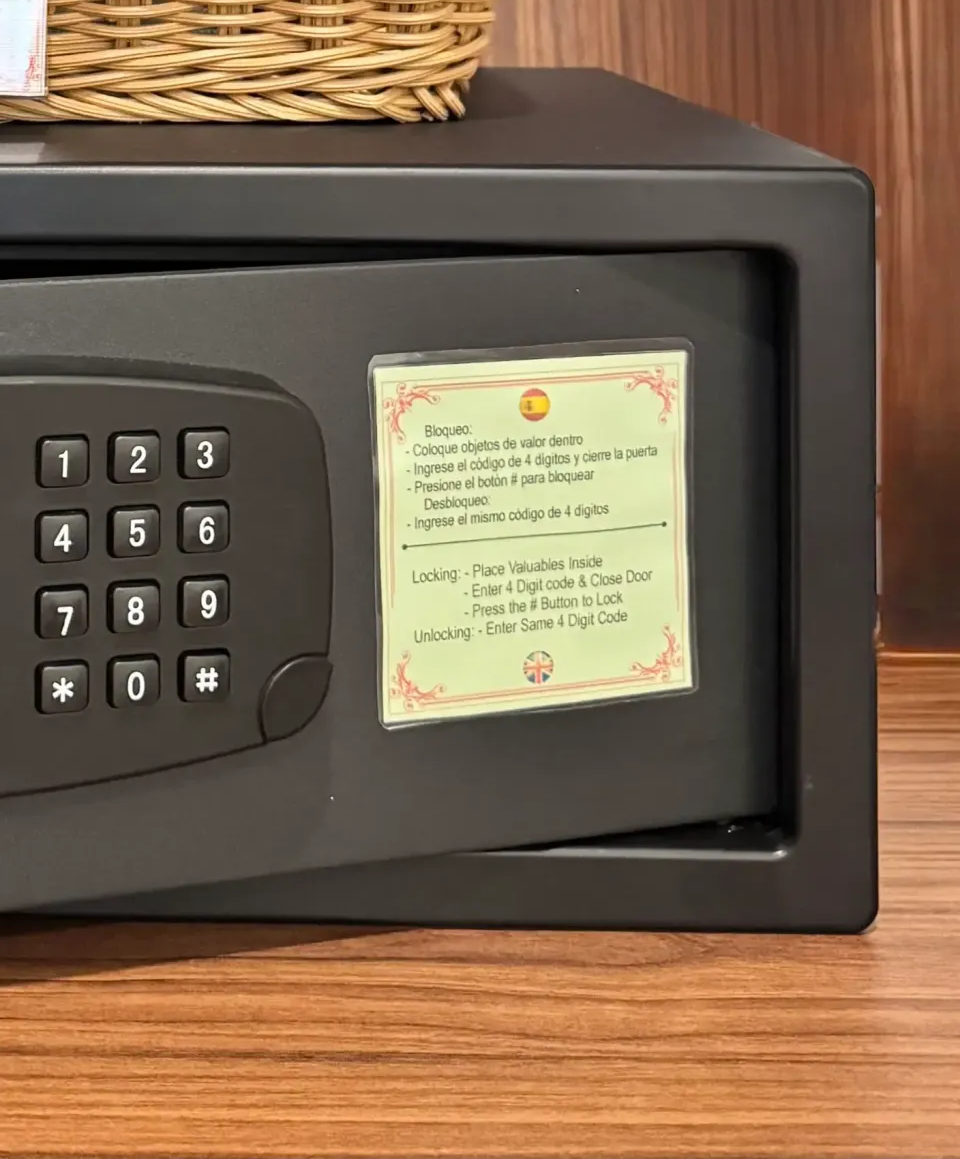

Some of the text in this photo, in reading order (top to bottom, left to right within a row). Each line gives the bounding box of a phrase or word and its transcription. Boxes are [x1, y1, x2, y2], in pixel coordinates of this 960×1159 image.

[413, 442, 458, 458] Coloque
[461, 439, 500, 456] objetos
[503, 437, 517, 450] de
[520, 436, 546, 449] valor
[549, 434, 584, 448] dentro
[424, 424, 473, 439] Bloqueo:
[58, 441, 214, 479] 1 2 3
[414, 462, 455, 478] Ingrese
[457, 458, 467, 472] el
[508, 455, 522, 468] de
[524, 453, 532, 466] 4
[573, 453, 580, 467] y
[582, 448, 611, 463] cierre
[614, 446, 624, 460] la
[626, 444, 658, 461] puerta
[415, 479, 462, 494] Presione
[464, 476, 475, 489] el
[511, 473, 518, 486] #
[521, 473, 545, 488] para
[548, 469, 595, 485] bloquear
[424, 495, 491, 511] Desbloqueo:
[414, 517, 455, 532] Ingrese
[457, 513, 467, 525] el
[471, 511, 506, 524] mismo
[548, 506, 561, 519] de
[564, 505, 571, 517] 4
[53, 516, 215, 553] 4 5 6
[412, 567, 461, 584] Locking:
[472, 563, 505, 578] Place
[508, 558, 565, 574] Valuables
[569, 554, 602, 570] Inside
[472, 583, 503, 598] Enter
[506, 580, 513, 593] 4
[516, 578, 543, 595] Digit
[545, 576, 575, 590] code
[578, 574, 587, 588] &
[590, 572, 622, 587] Close
[626, 569, 653, 583] Door
[57, 590, 218, 636] 7 8 9
[472, 603, 505, 618] Press
[509, 600, 527, 614] the
[530, 598, 537, 611] #
[541, 596, 578, 610] Button
[582, 594, 593, 607] to
[596, 591, 623, 606] Lock
[414, 626, 474, 643] Unlocking:
[486, 620, 517, 635] Enter
[520, 617, 554, 632] Same
[557, 614, 564, 627] 4
[568, 612, 594, 630] Digit
[597, 609, 628, 625] Code
[127, 671, 145, 701] 0
[195, 667, 219, 693] #
